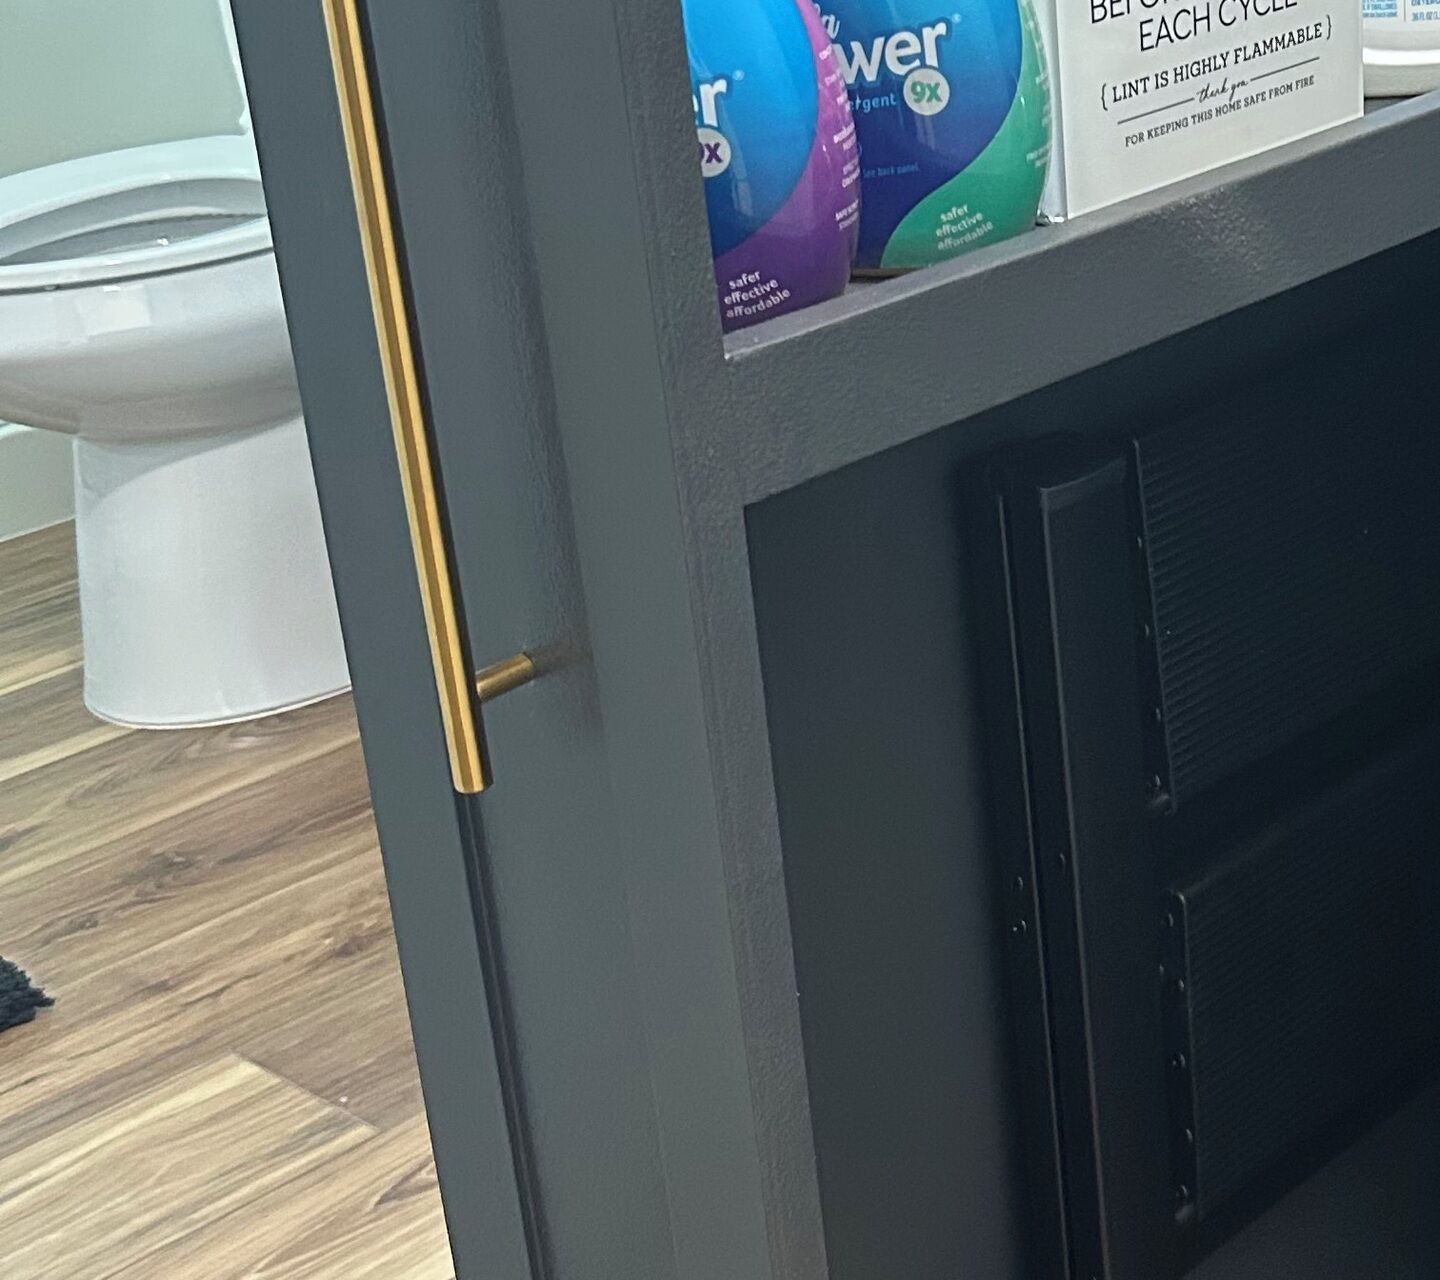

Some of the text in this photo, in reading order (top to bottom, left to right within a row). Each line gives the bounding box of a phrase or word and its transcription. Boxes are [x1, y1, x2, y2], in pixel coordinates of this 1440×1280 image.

[1139, 2, 1210, 52] EACH
[831, 21, 947, 84] wer
[1112, 78, 1150, 103] LINT
[1154, 71, 1169, 90] IS
[1173, 51, 1229, 84] HIGHLY
[1234, 23, 1322, 64] FLAMMABLE
[1125, 75, 1315, 147] FOR KEEPING THIS HOME SAFE FROM FIRE
[700, 142, 723, 164] X
[936, 213, 983, 237] effective
[940, 204, 968, 222] safer
[938, 221, 994, 251] affordable
[724, 279, 779, 305] effective
[729, 271, 761, 289] safer
[726, 289, 791, 318] affordable
